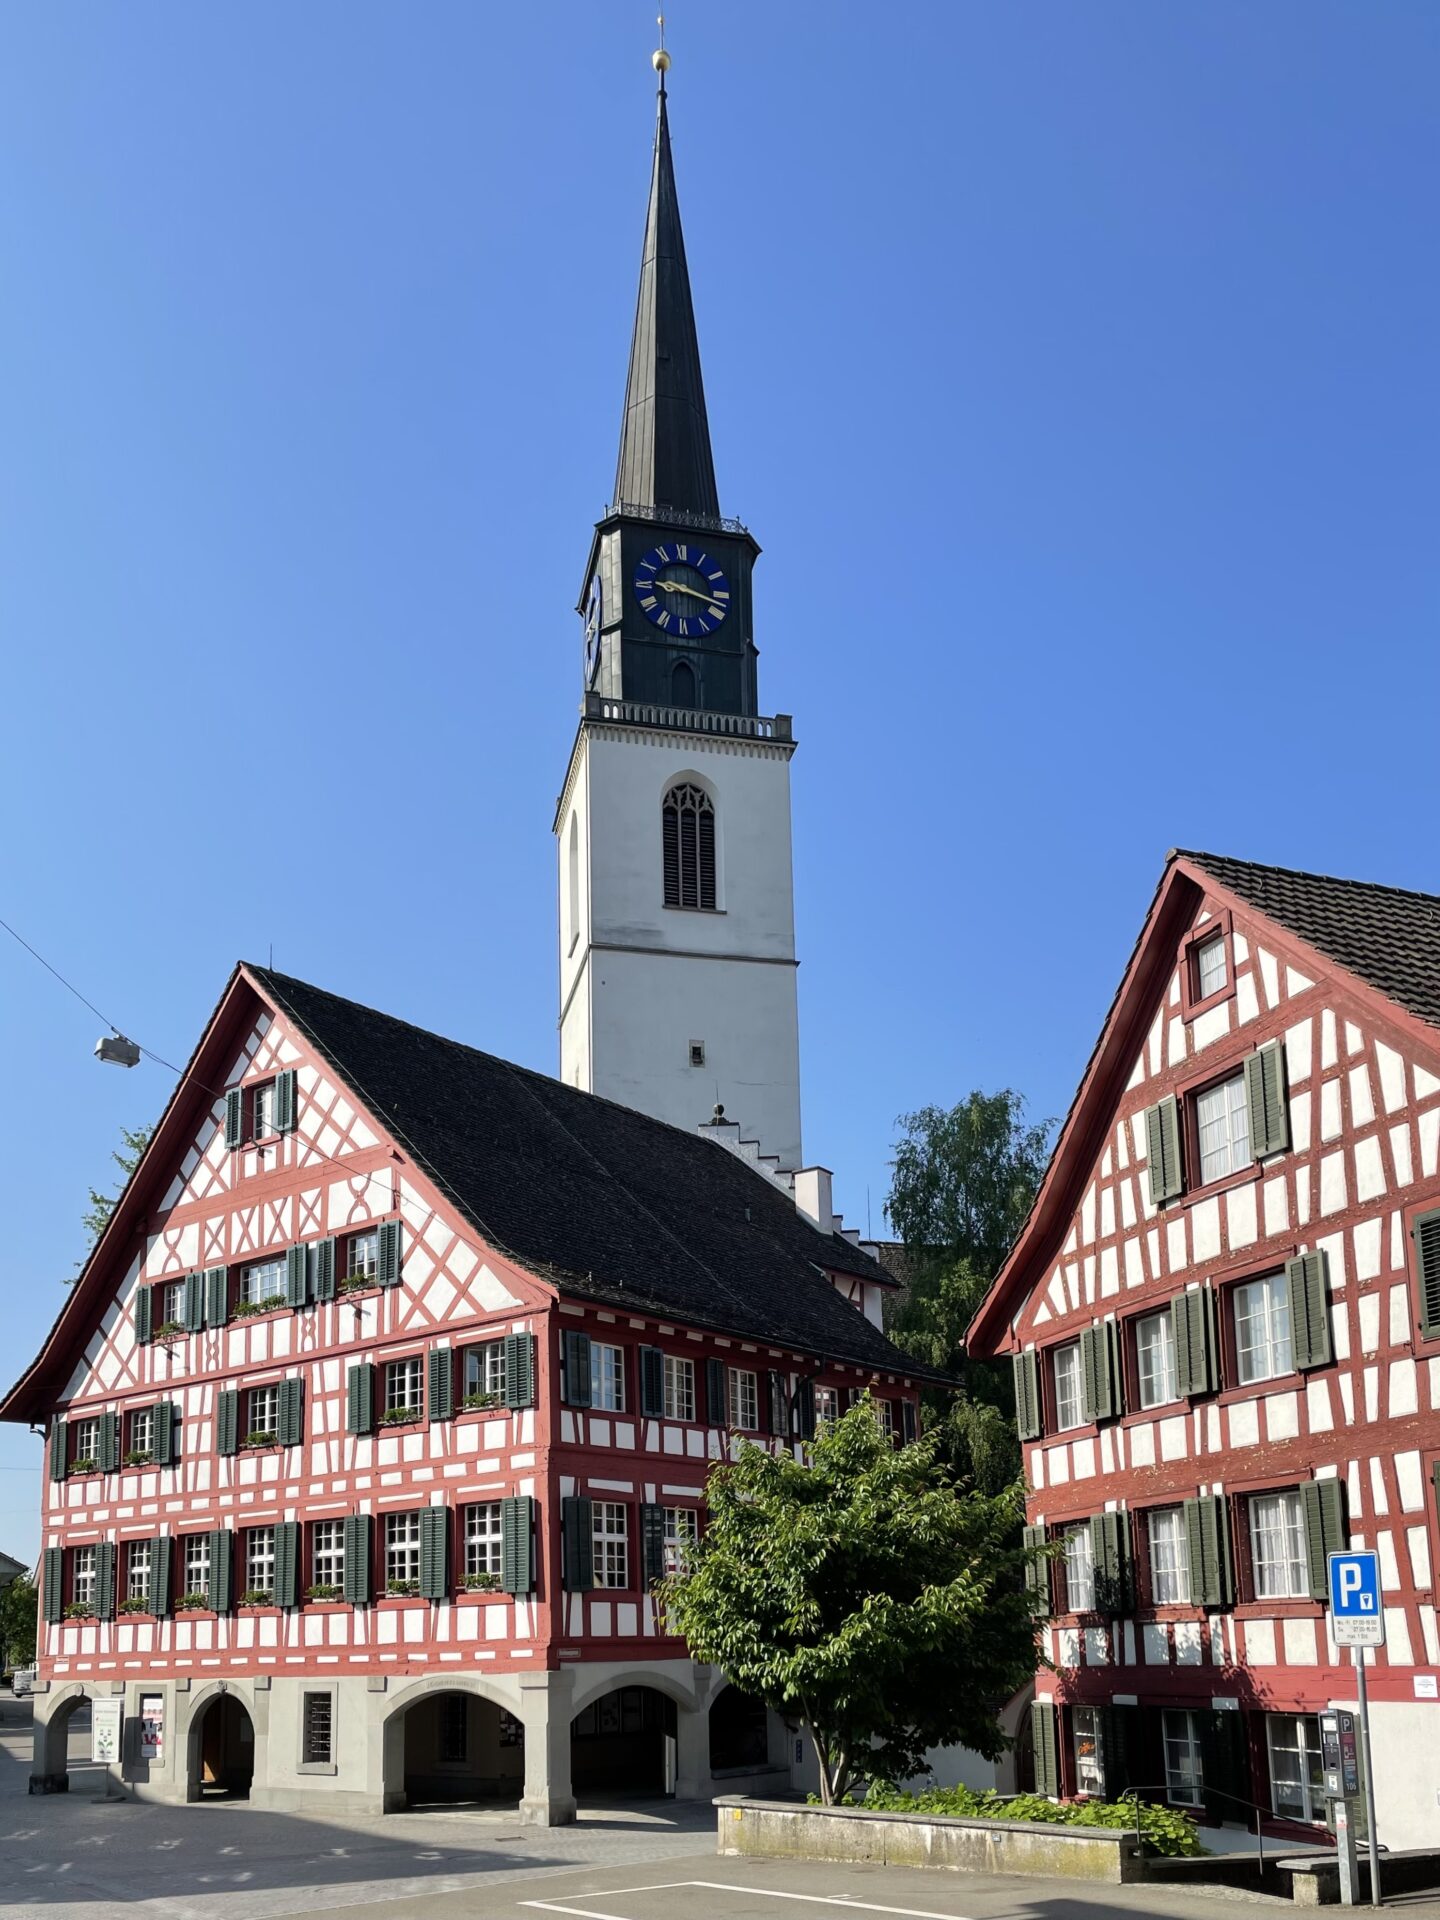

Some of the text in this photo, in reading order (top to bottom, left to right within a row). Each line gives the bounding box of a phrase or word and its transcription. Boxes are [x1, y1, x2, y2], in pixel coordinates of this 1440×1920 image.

[655, 546, 670, 563] XI
[676, 544, 687, 561] XII
[697, 553, 706, 567] I
[640, 559, 657, 574] X
[708, 570, 724, 581] II
[635, 578, 652, 589] IX
[713, 591, 730, 599] III
[640, 595, 659, 613] VIII
[656, 610, 671, 628] VII
[679, 618, 689, 635] VI
[698, 617, 710, 632] V
[1339, 1563, 1362, 1608] P
[1343, 1718, 1350, 1731] P
